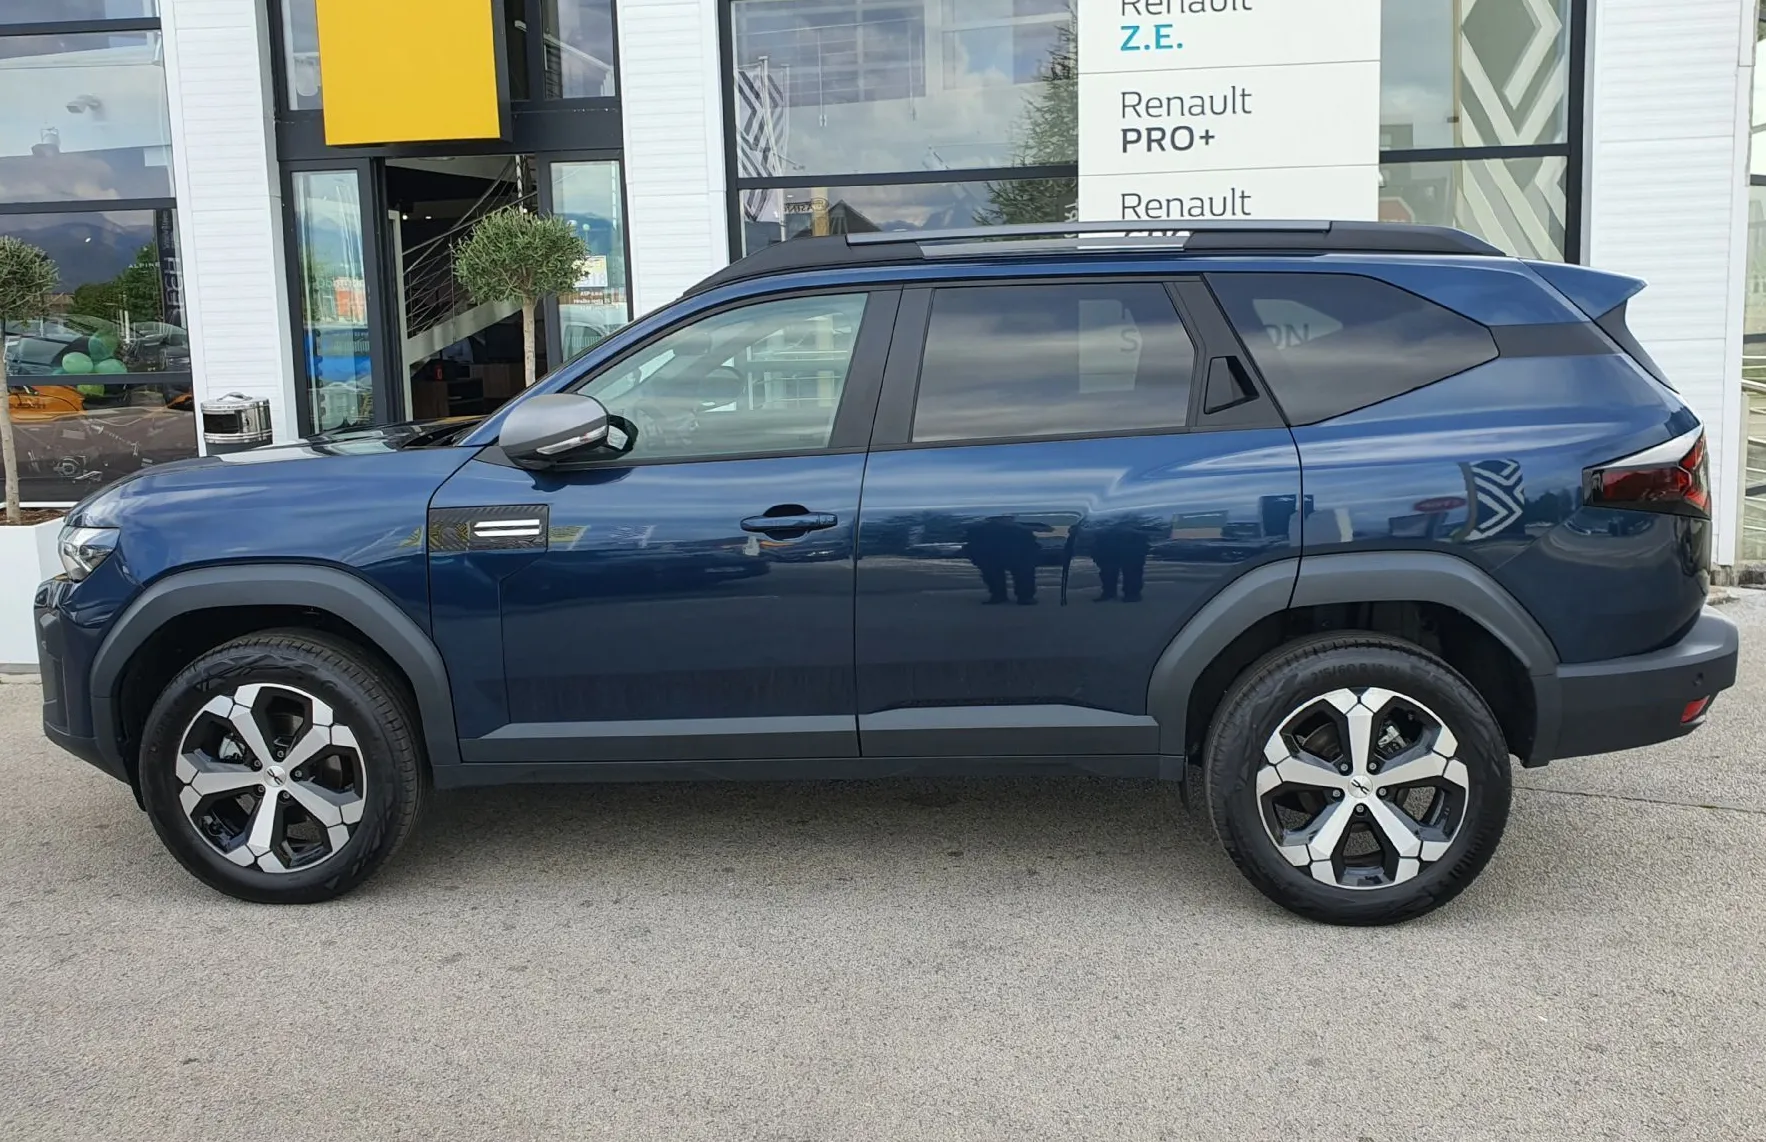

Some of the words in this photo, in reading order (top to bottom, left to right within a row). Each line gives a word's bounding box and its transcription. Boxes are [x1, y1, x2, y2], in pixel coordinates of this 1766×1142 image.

[1120, 23, 1184, 51] Z.E.
[1121, 85, 1252, 119] Renault
[1121, 125, 1215, 154] PRO+
[1121, 187, 1252, 220] Renault
